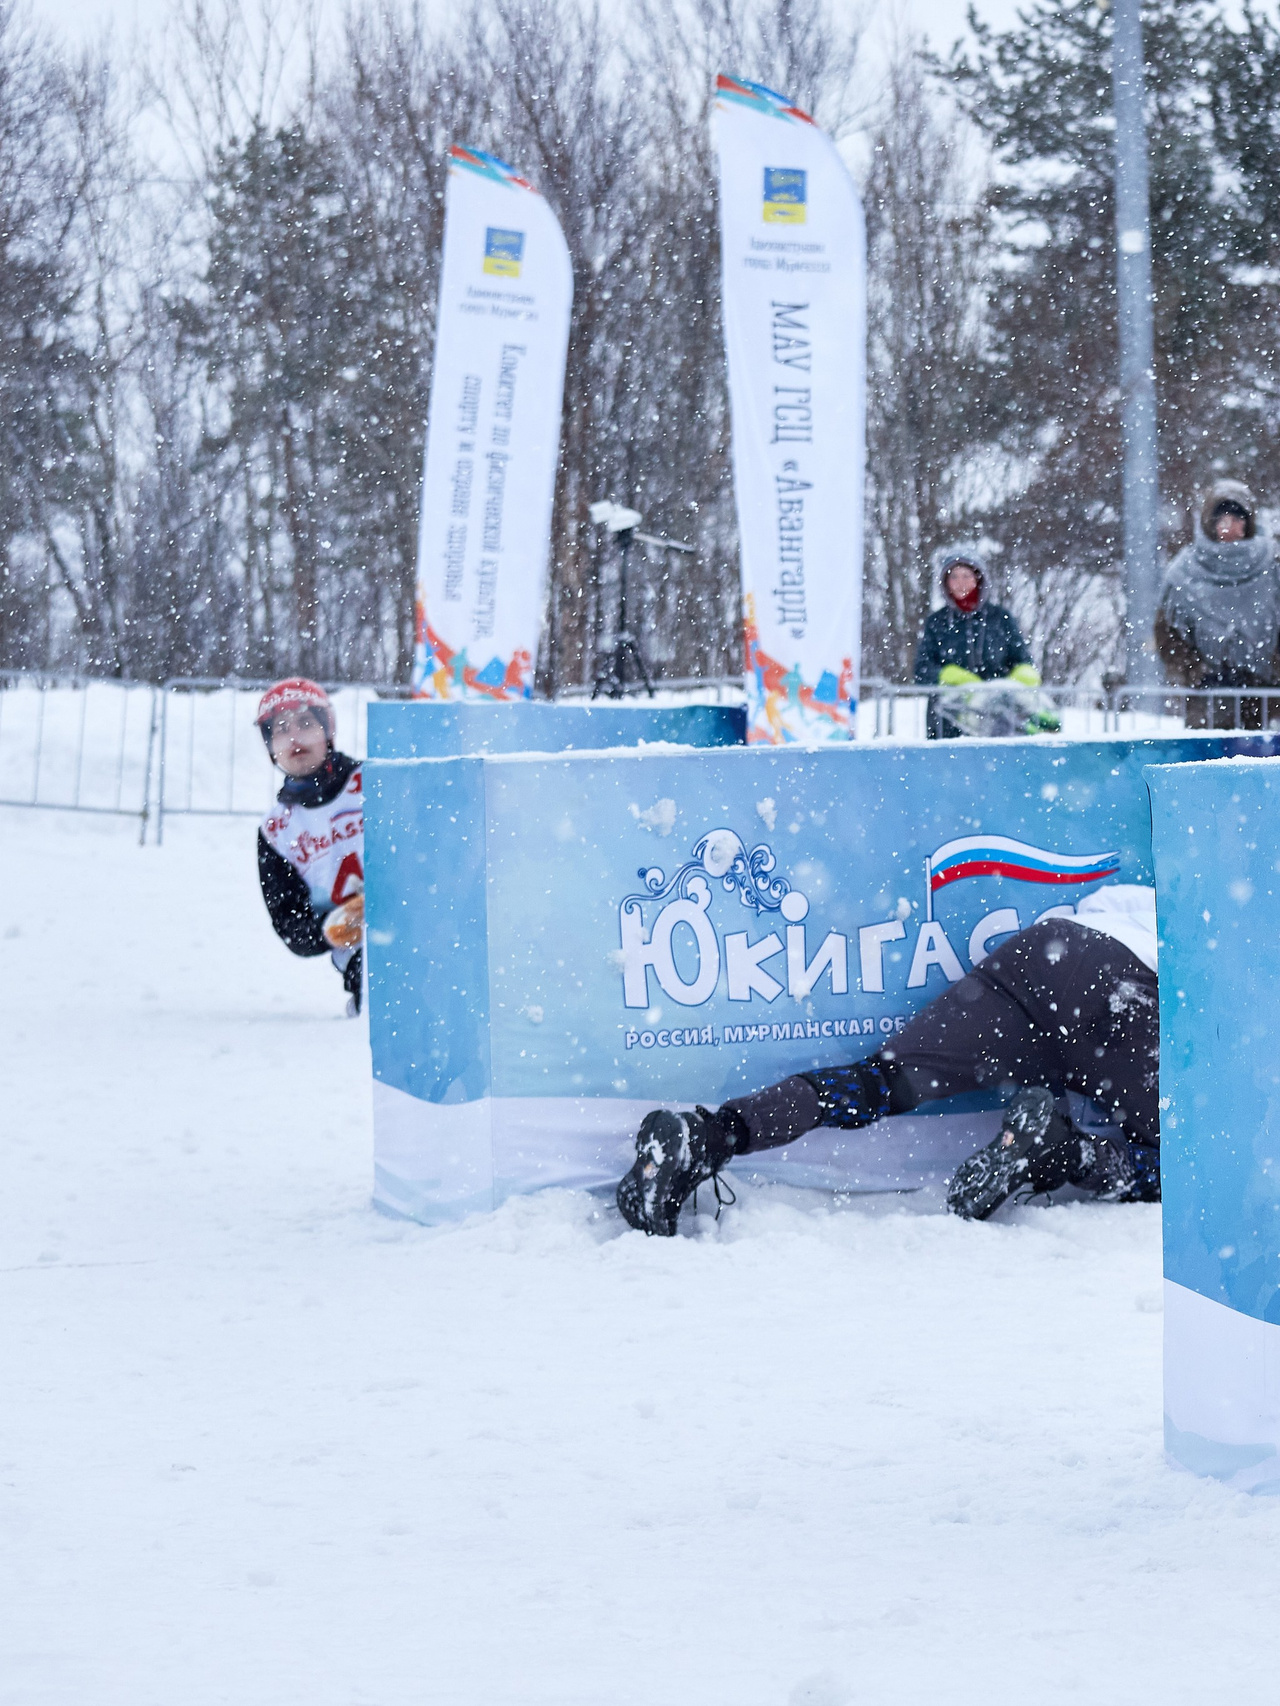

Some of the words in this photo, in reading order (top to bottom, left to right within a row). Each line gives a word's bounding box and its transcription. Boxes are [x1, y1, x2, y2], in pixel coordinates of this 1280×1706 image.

[770, 301, 812, 374] МАУ
[770, 385, 813, 445] ГСЦ
[772, 459, 814, 640] «Авангард»
[625, 1024, 720, 1049] РОССИЯ,
[724, 1018, 875, 1043] МУРМАНСКАЯ
